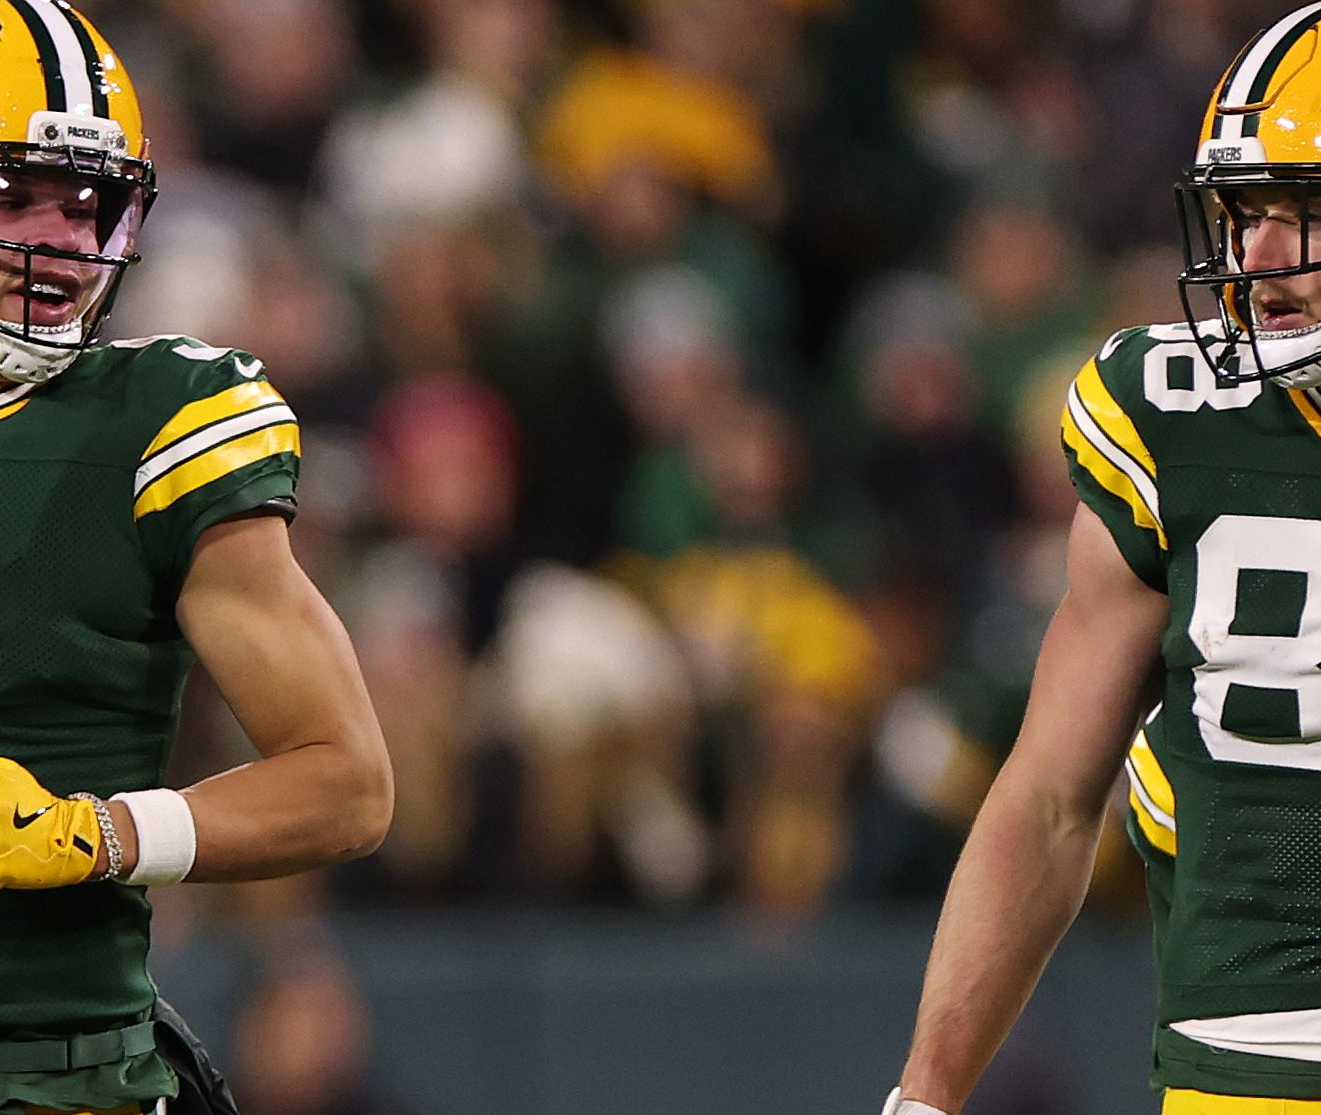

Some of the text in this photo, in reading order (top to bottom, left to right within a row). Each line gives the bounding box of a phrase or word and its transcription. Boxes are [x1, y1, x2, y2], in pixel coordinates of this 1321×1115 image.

[67, 126, 100, 141] PACKERS
[1208, 146, 1243, 163] PACKERS
[1144, 318, 1263, 412] 88
